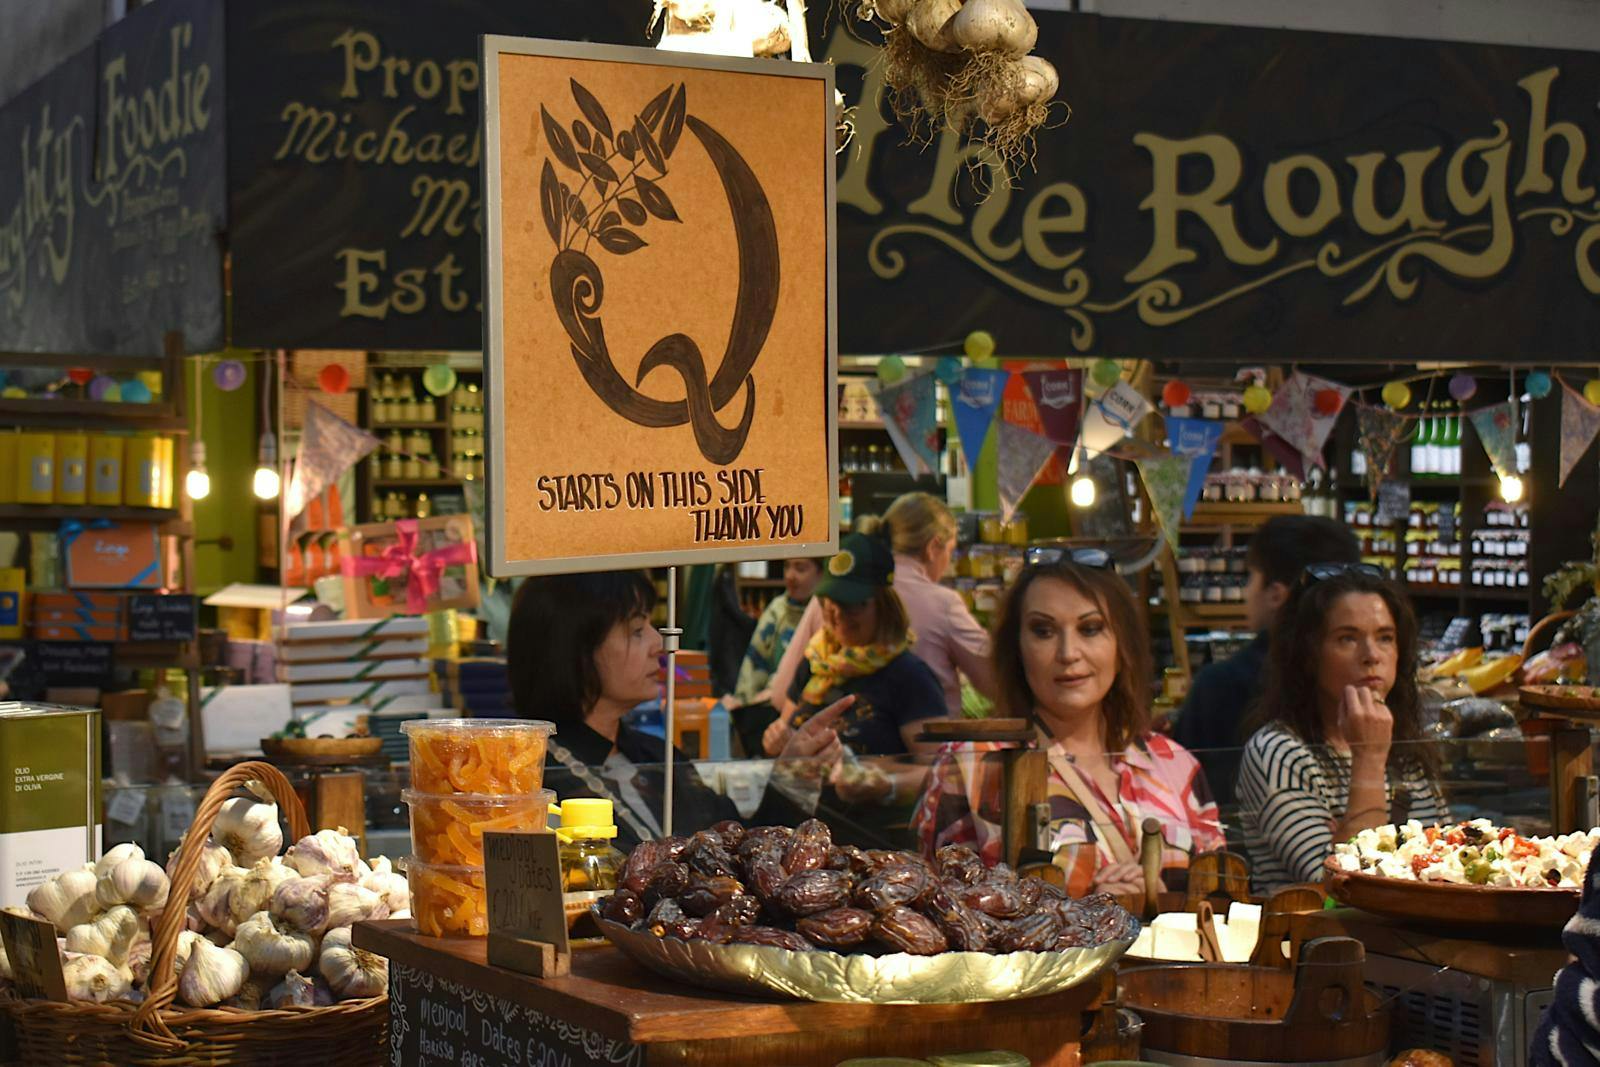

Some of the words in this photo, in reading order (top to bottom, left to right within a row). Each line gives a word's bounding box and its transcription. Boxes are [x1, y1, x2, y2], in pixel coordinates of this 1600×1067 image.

[104, 21, 211, 181] Foodie
[822, 24, 1088, 270] The
[1125, 66, 1596, 284] Rough
[537, 473, 622, 512] STARTS
[625, 472, 654, 508] ON
[659, 470, 712, 508] THIS
[717, 468, 766, 505] SIDE
[690, 505, 761, 542] THANK
[767, 504, 804, 540] YOU
[15, 767, 30, 775] OLIO
[15, 775, 35, 783] EXTRA
[36, 773, 64, 782] VERGINE
[23, 783, 42, 791] OLIVA
[481, 1018, 522, 1065] Dates
